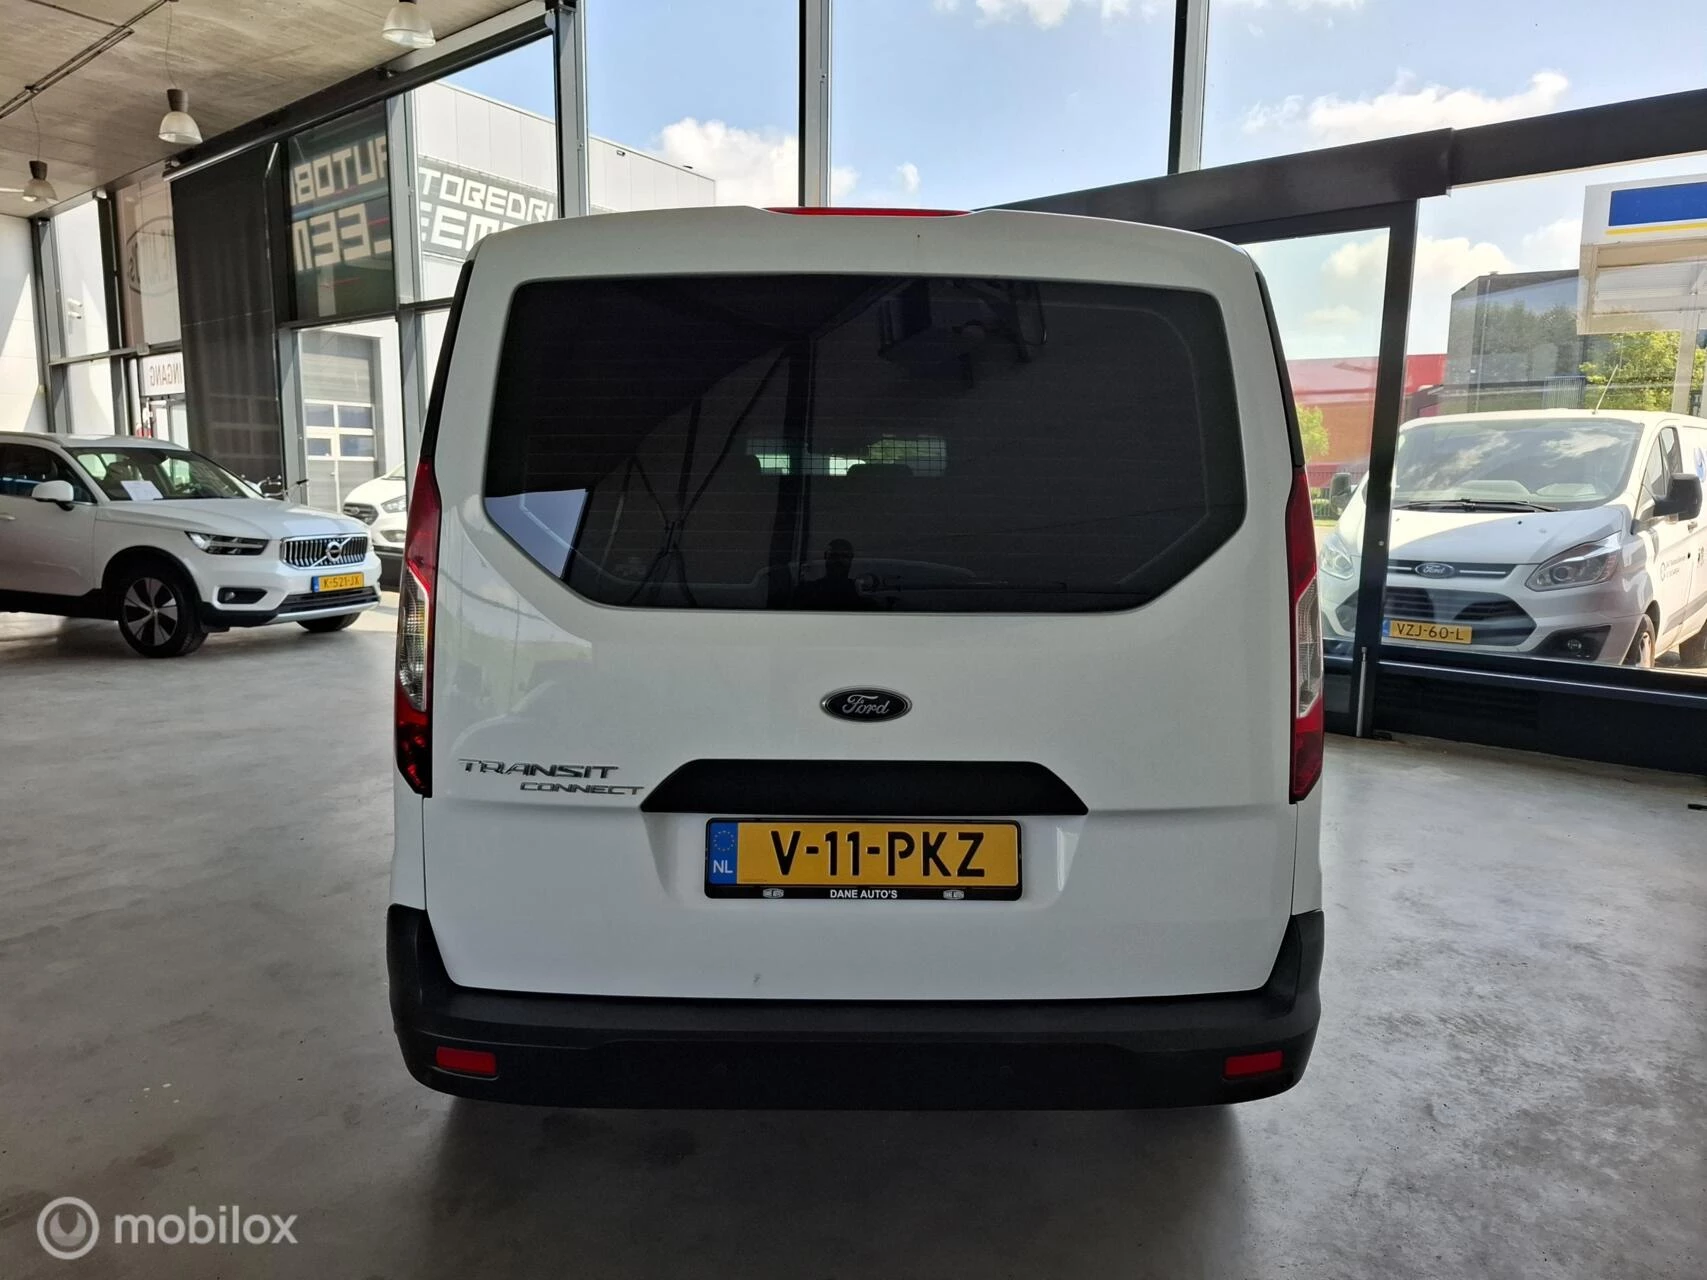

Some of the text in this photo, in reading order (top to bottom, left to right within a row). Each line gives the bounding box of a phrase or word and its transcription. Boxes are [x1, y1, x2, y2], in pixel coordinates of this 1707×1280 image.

[1422, 565, 1446, 574] Ford
[323, 575, 360, 589] K-521-JX
[1397, 623, 1464, 641] VZJ-60-L
[842, 694, 890, 714] Ford
[458, 758, 619, 779] TRANSIT
[520, 782, 645, 795] CONNECT
[771, 830, 985, 877] V-11-PKZ
[713, 859, 733, 874] NL
[830, 889, 898, 899] DANE AUTO'S
